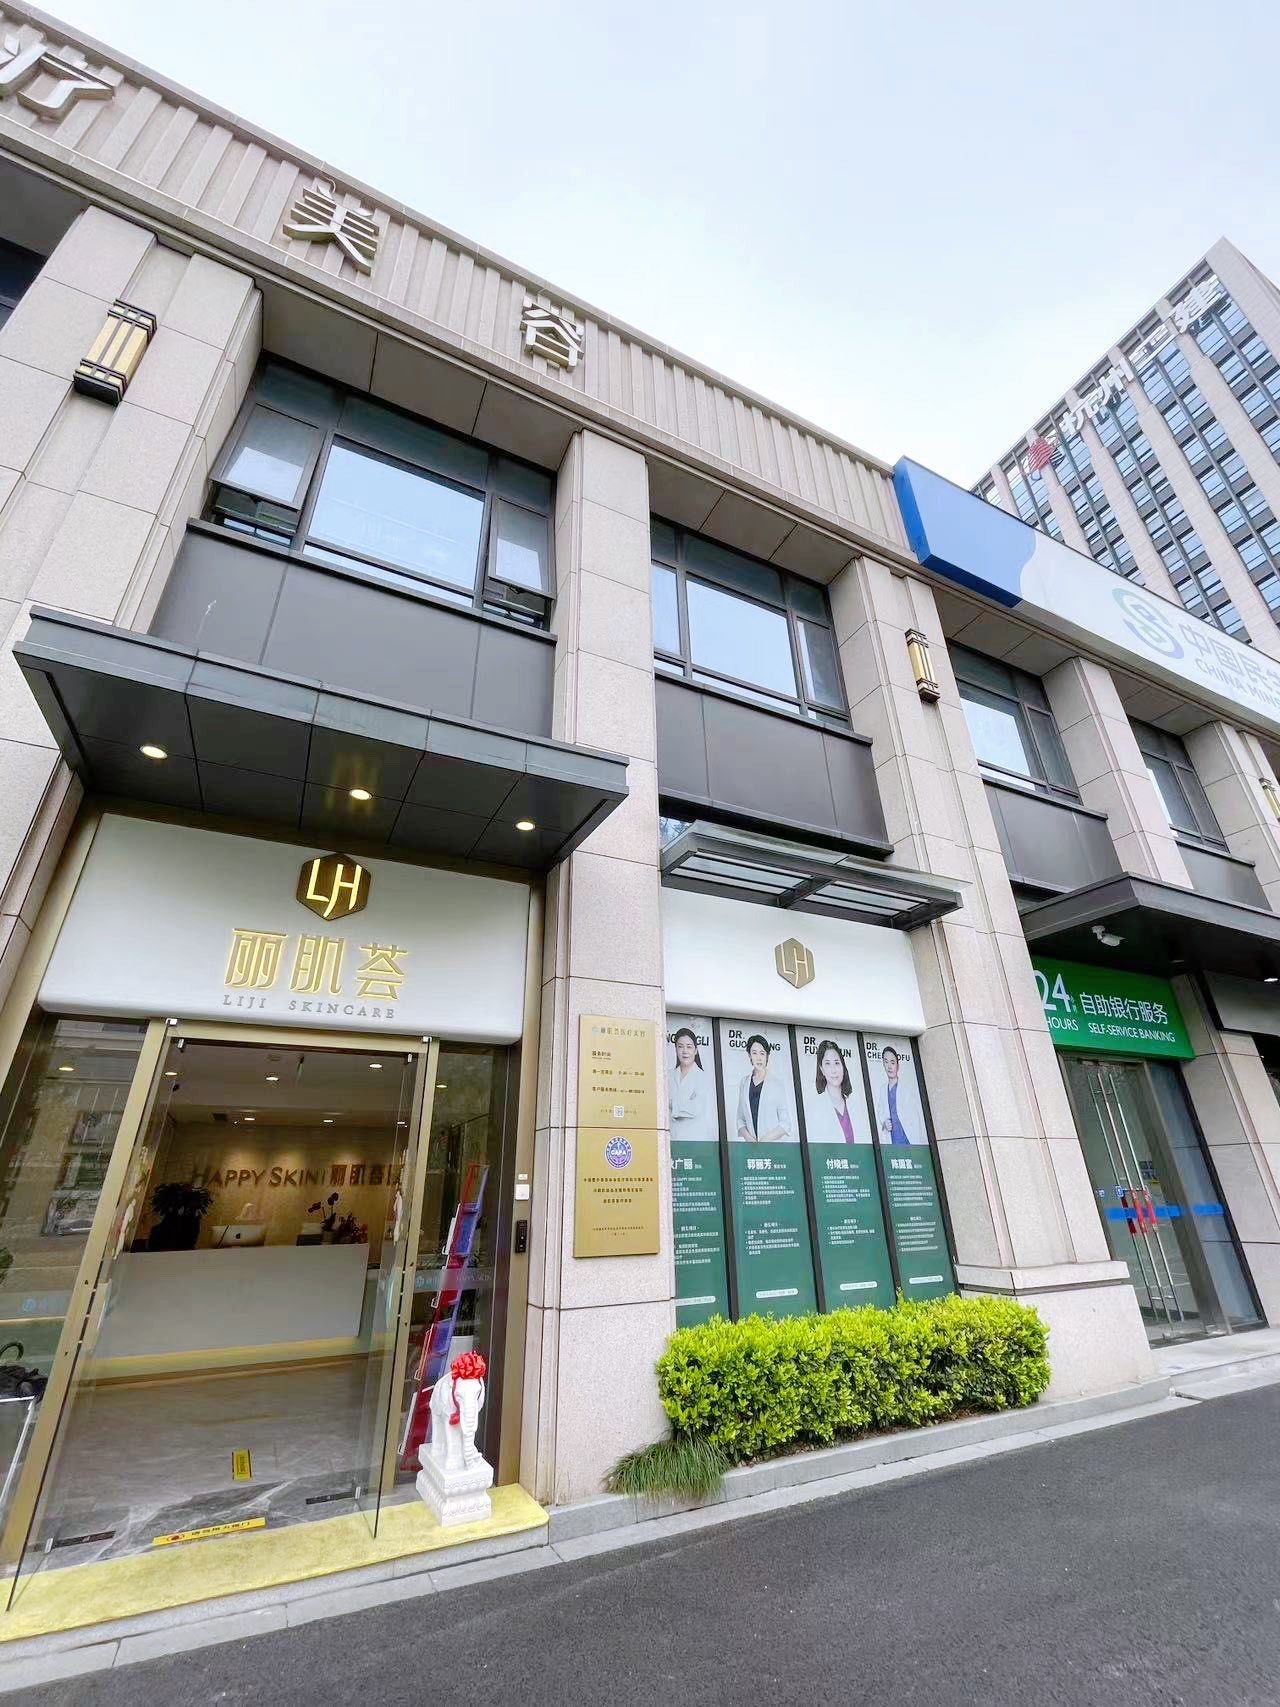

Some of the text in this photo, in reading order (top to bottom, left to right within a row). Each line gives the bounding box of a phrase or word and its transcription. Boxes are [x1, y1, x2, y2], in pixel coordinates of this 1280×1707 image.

[1196, 658, 1248, 694] CHINA
[224, 928, 408, 1000] 丽肌荟
[223, 994, 395, 1019] LIJI SKINCARE
[1079, 992, 1168, 1025] 自助银行服务
[1139, 1028, 1175, 1043] BANKING
[268, 1166, 319, 1187] SKIN
